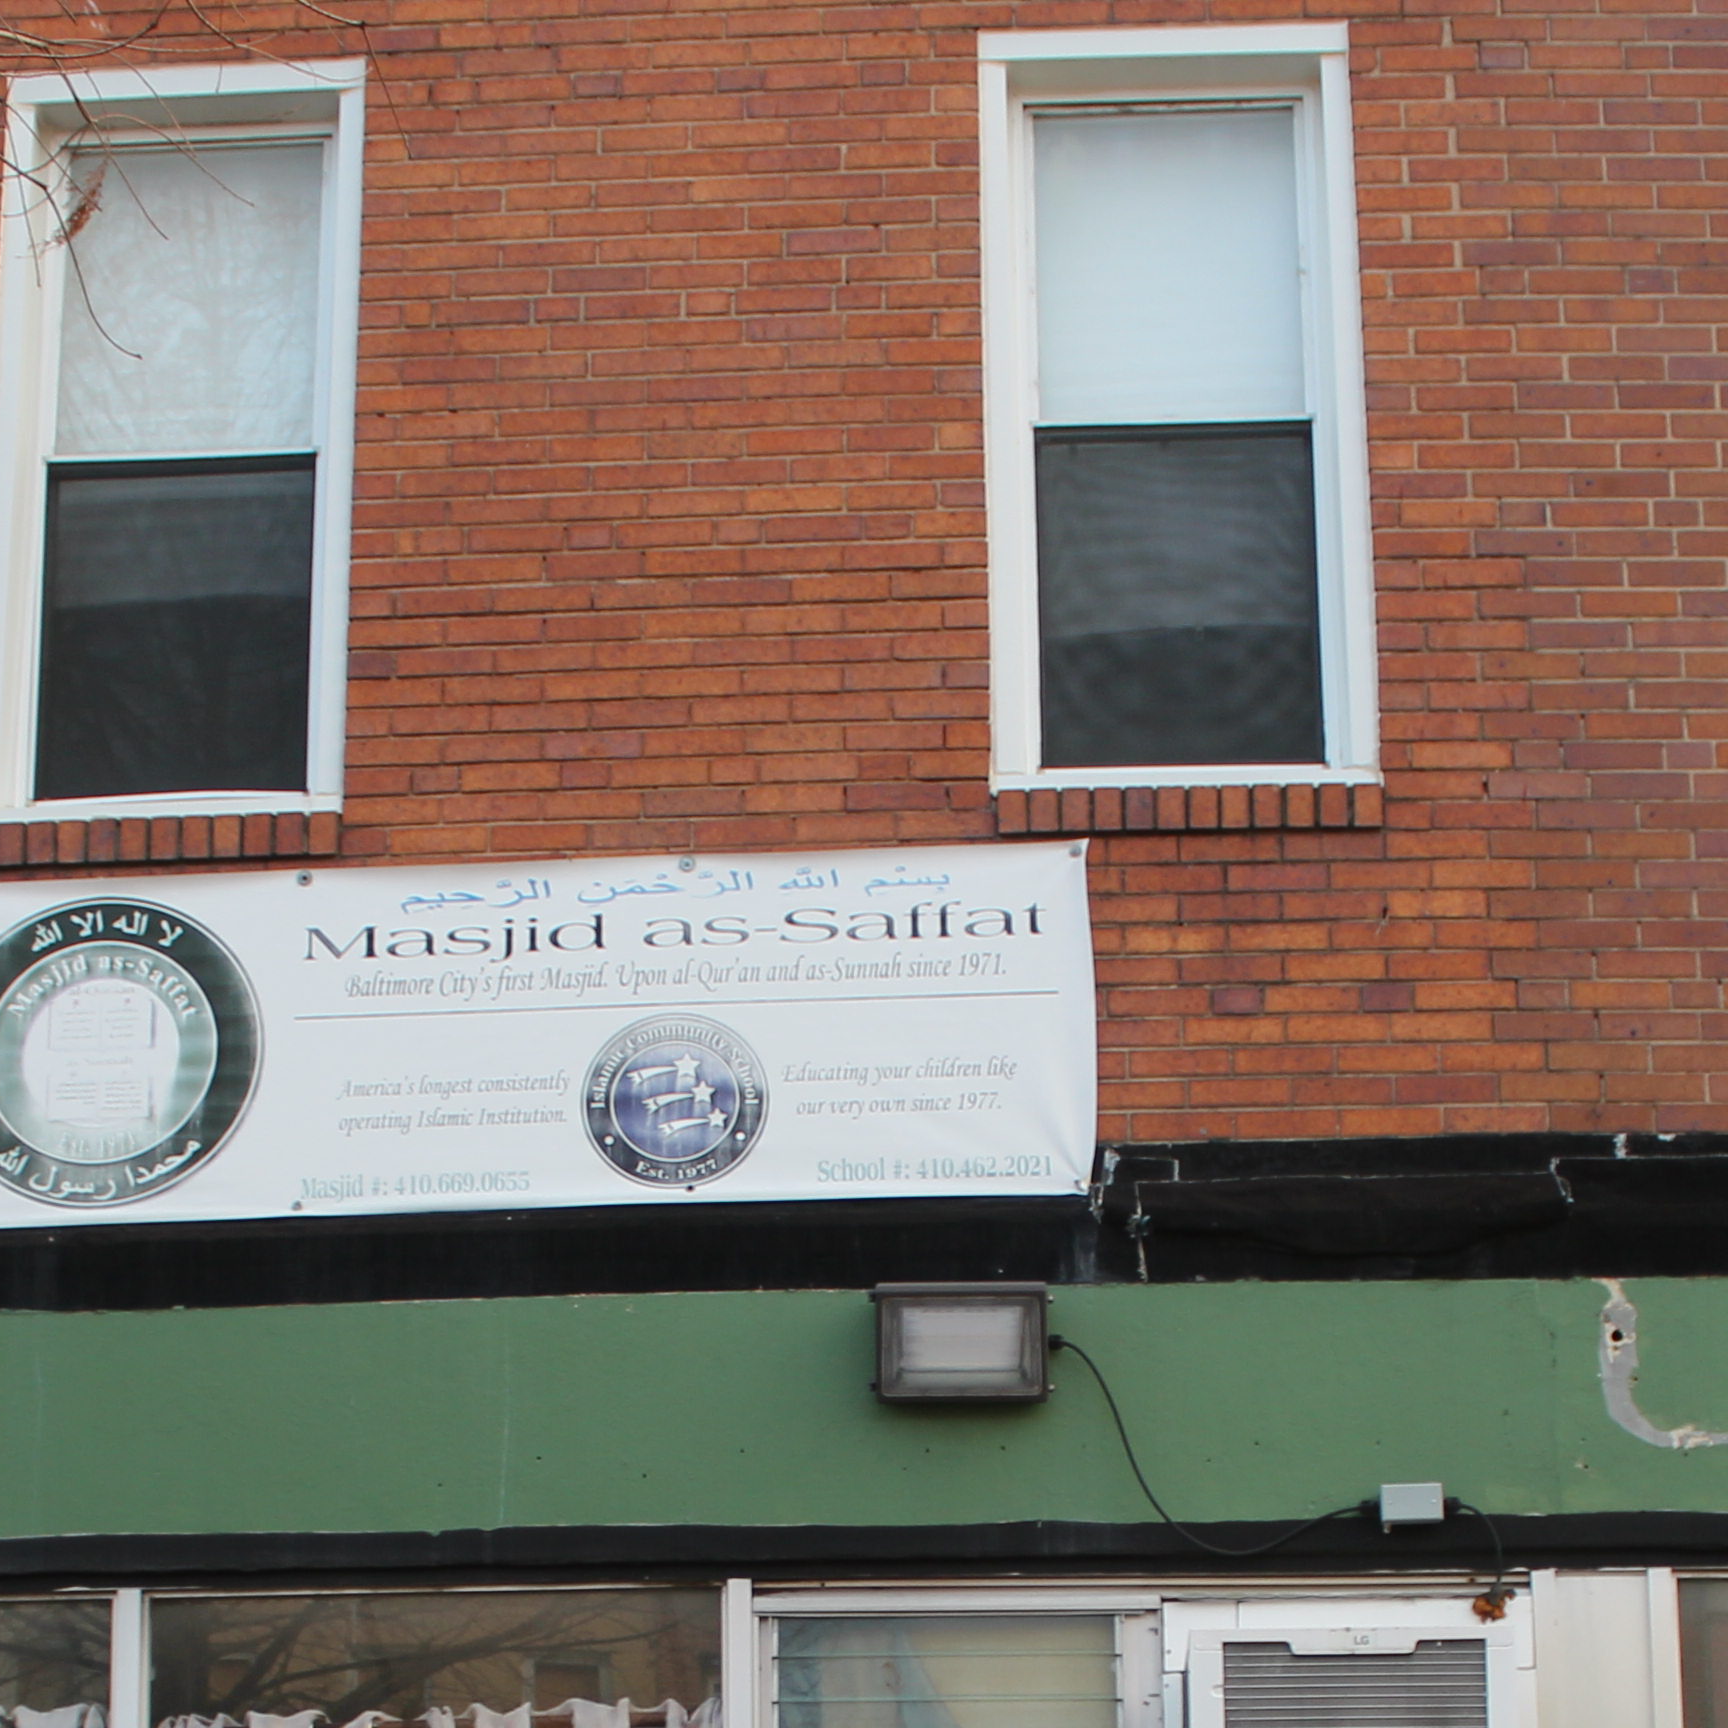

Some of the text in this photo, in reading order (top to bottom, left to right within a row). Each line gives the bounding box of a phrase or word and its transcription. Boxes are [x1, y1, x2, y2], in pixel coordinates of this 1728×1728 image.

[305, 900, 1048, 963] Masjid as-Saffat
[7, 953, 198, 1018] Masjid as-Saffat
[344, 952, 1007, 1001] Baltimore City's first Masjid. Upon al-Qur'an and as-Sunnah since 1971.
[591, 1024, 760, 1108] Islamic Community School
[781, 1055, 1018, 1086] Educating your children like
[336, 1069, 570, 1100] America's longest consistently
[338, 1105, 568, 1136] operating Islamic Institution.
[796, 1091, 1002, 1119] our very own since 1977.
[635, 1159, 718, 1180] Est. 1977
[817, 1157, 886, 1183] School
[916, 1155, 1053, 1179] 410.462.2021
[300, 1174, 364, 1201] Masjid
[394, 1170, 531, 1195] 410.669.0655
[1353, 1635, 1370, 1645] LG
